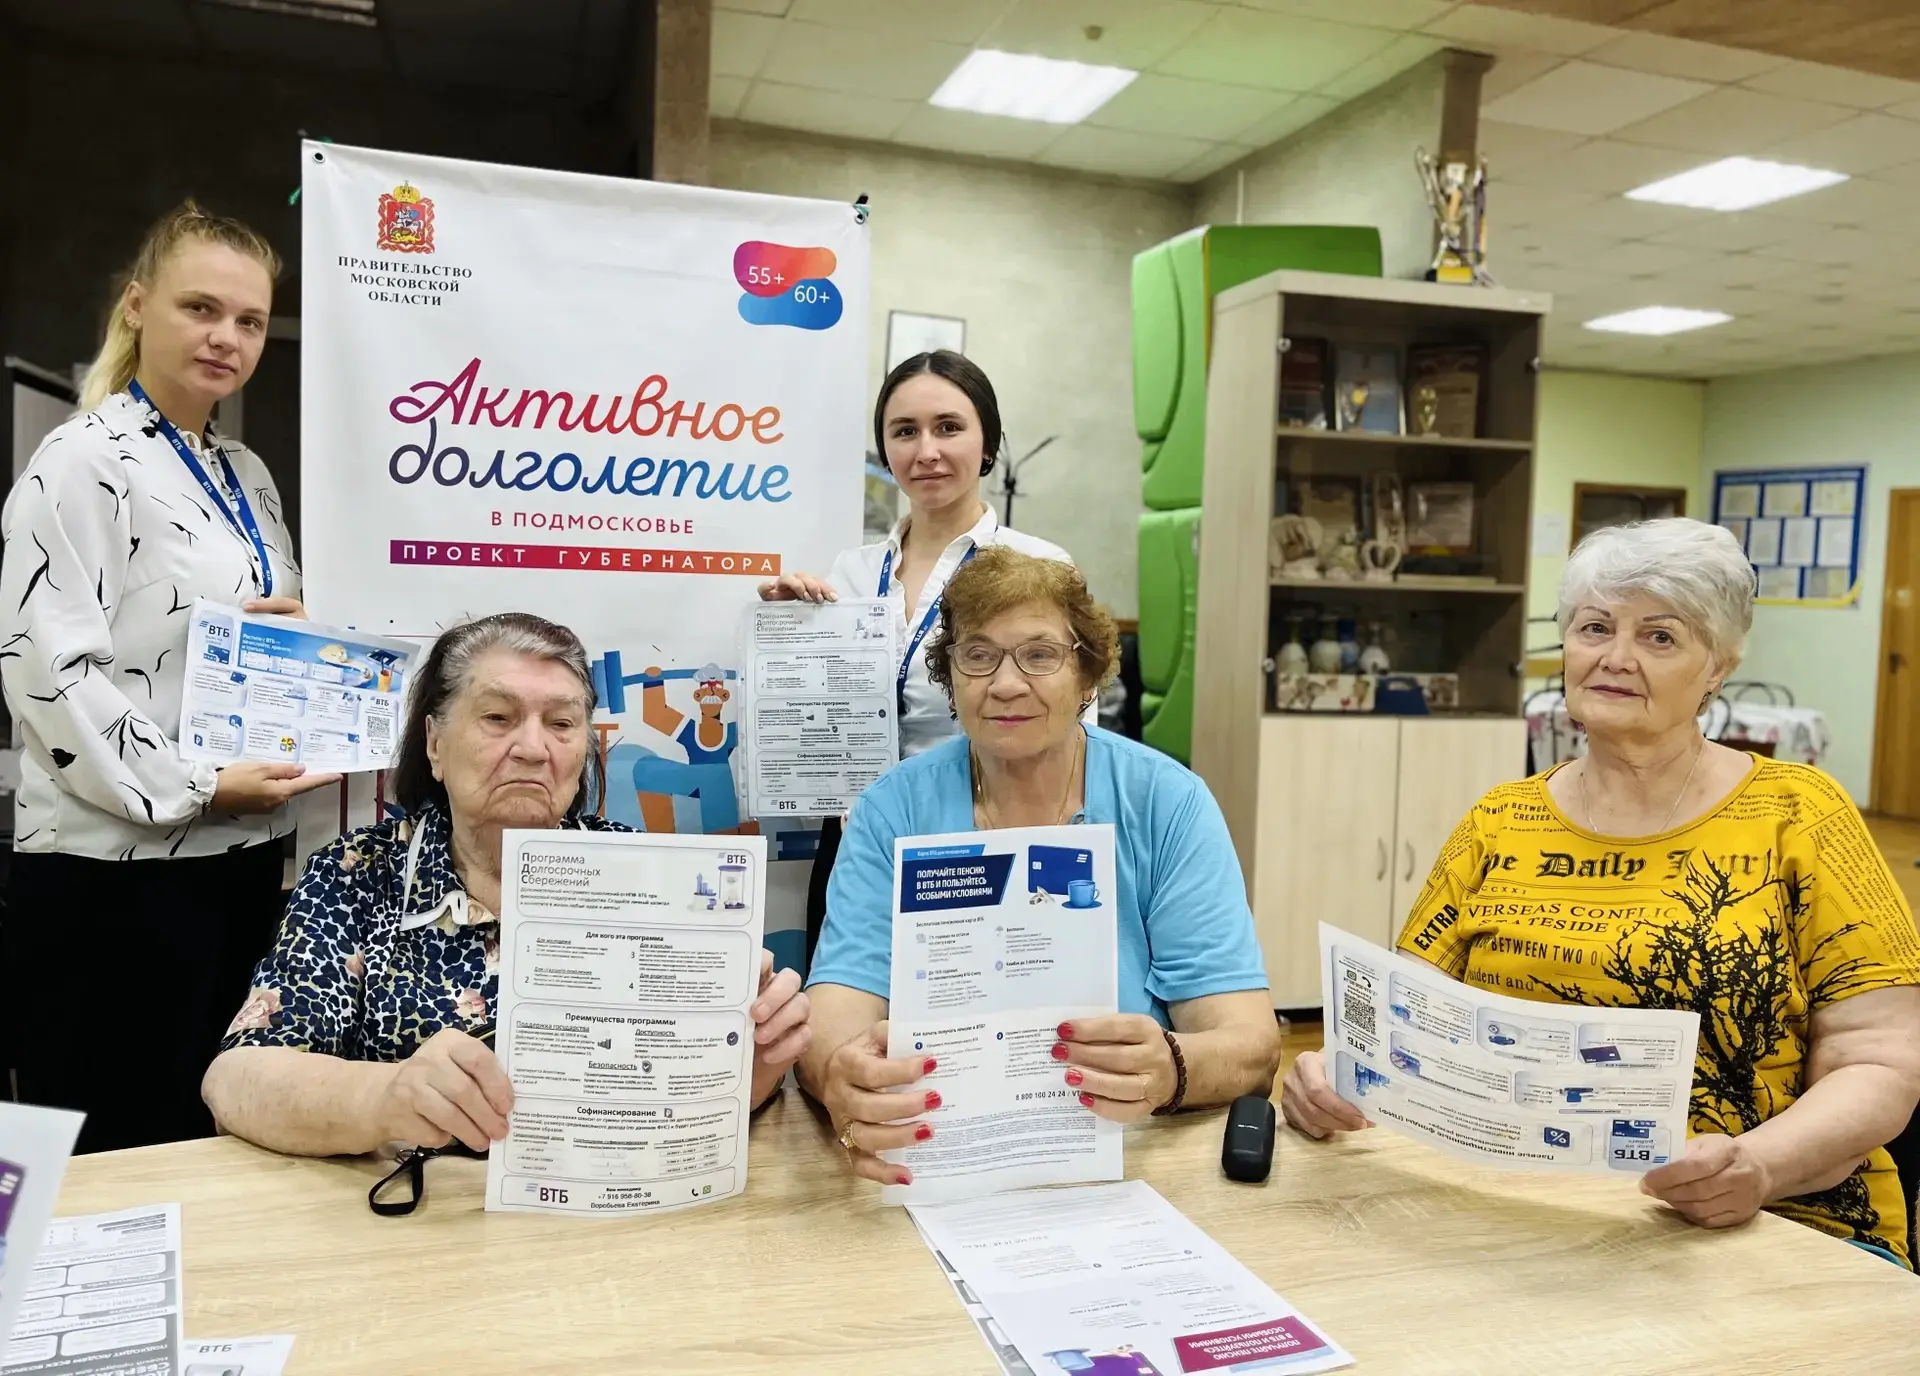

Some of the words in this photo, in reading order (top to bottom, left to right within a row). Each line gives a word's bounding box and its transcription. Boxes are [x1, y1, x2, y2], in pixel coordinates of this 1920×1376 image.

[337, 256, 474, 279] ПРАВИТЕЛЬСТВО
[349, 272, 461, 293] МОСКОВСКОЙ
[747, 265, 786, 287] 55+
[367, 291, 443, 307] ОБЛАСТИ
[793, 285, 831, 305] 60+
[389, 357, 785, 444] Активное
[490, 511, 502, 528] В
[513, 512, 695, 534] ПОДМОСКОВЬЕ
[403, 545, 527, 564] ПРОЕКТ
[558, 549, 773, 573] ГУБЕРНАТОРА
[208, 625, 230, 638] ВТБ
[375, 698, 390, 707] ВТБ
[779, 801, 797, 810] ВТБ
[1511, 802, 1548, 812] BETWEE
[1513, 812, 1550, 821] CREATES
[521, 852, 586, 865] Программа
[726, 854, 748, 865] ВТБ
[1535, 849, 1647, 880] Daily
[520, 863, 601, 876] Долгосрочных
[916, 866, 956, 879] ПОЛУЧАЙТЕ
[956, 865, 986, 876] ПЕНСИЮ
[520, 874, 590, 887] Сбережений
[916, 881, 921, 890] В
[922, 880, 935, 890] ВТБ
[935, 879, 941, 888] И
[941, 876, 987, 888] ПОЛЬЗУЙТЕСЬ
[916, 890, 952, 901] ОСОБЫМИ
[951, 887, 993, 899] УСЛОВИЯМИ
[1468, 903, 1562, 918] VERSEAS
[1569, 905, 1679, 920] CONFLIC
[1413, 903, 1460, 952] EXTRA
[630, 951, 636, 959] 3
[1491, 936, 1548, 959] BETWEEN
[1553, 944, 1583, 965] TWO
[1505, 976, 1535, 992] and
[565, 1012, 625, 1023] Преимущества
[626, 1017, 677, 1026] программы
[516, 1020, 552, 1030] Поддержка
[552, 1024, 590, 1033] государства
[634, 1028, 676, 1037] Доступность
[1346, 1036, 1366, 1052] ВТБ
[588, 1060, 638, 1071] Безопасность
[1015, 1093, 1020, 1101] 8
[1021, 1092, 1033, 1100] 800
[1034, 1091, 1046, 1099] 100
[1047, 1090, 1056, 1098] 24
[576, 1106, 657, 1119] Софинансирование
[1377, 1107, 1404, 1121] (ПИФ)
[1405, 1117, 1436, 1133] фонды
[1437, 1132, 1515, 1157] инвестиционные
[1517, 1152, 1555, 1161] Паевые
[1613, 1149, 1651, 1161] ВТБ
[539, 1187, 569, 1204] ВТБ
[619, 1191, 652, 1200] 958-80-38
[590, 1201, 626, 1210] Воробьева
[626, 1199, 661, 1208] Екатерина
[1241, 1326, 1286, 1339] ОСОБЫМИ
[1268, 1334, 1286, 1343] ВТБ
[199, 1343, 233, 1353] ВТБ
[1188, 1335, 1241, 1348] УСЛОВИЯМИ
[1203, 1339, 1261, 1354] ПОЛЬЗУЙТЕСЬ
[1251, 1340, 1301, 1354] ПОЛУЧАЙТЕ
[113, 1344, 168, 1357] ПОДХОДИТ
[1212, 1347, 1252, 1361] ПЕНСИЮ
